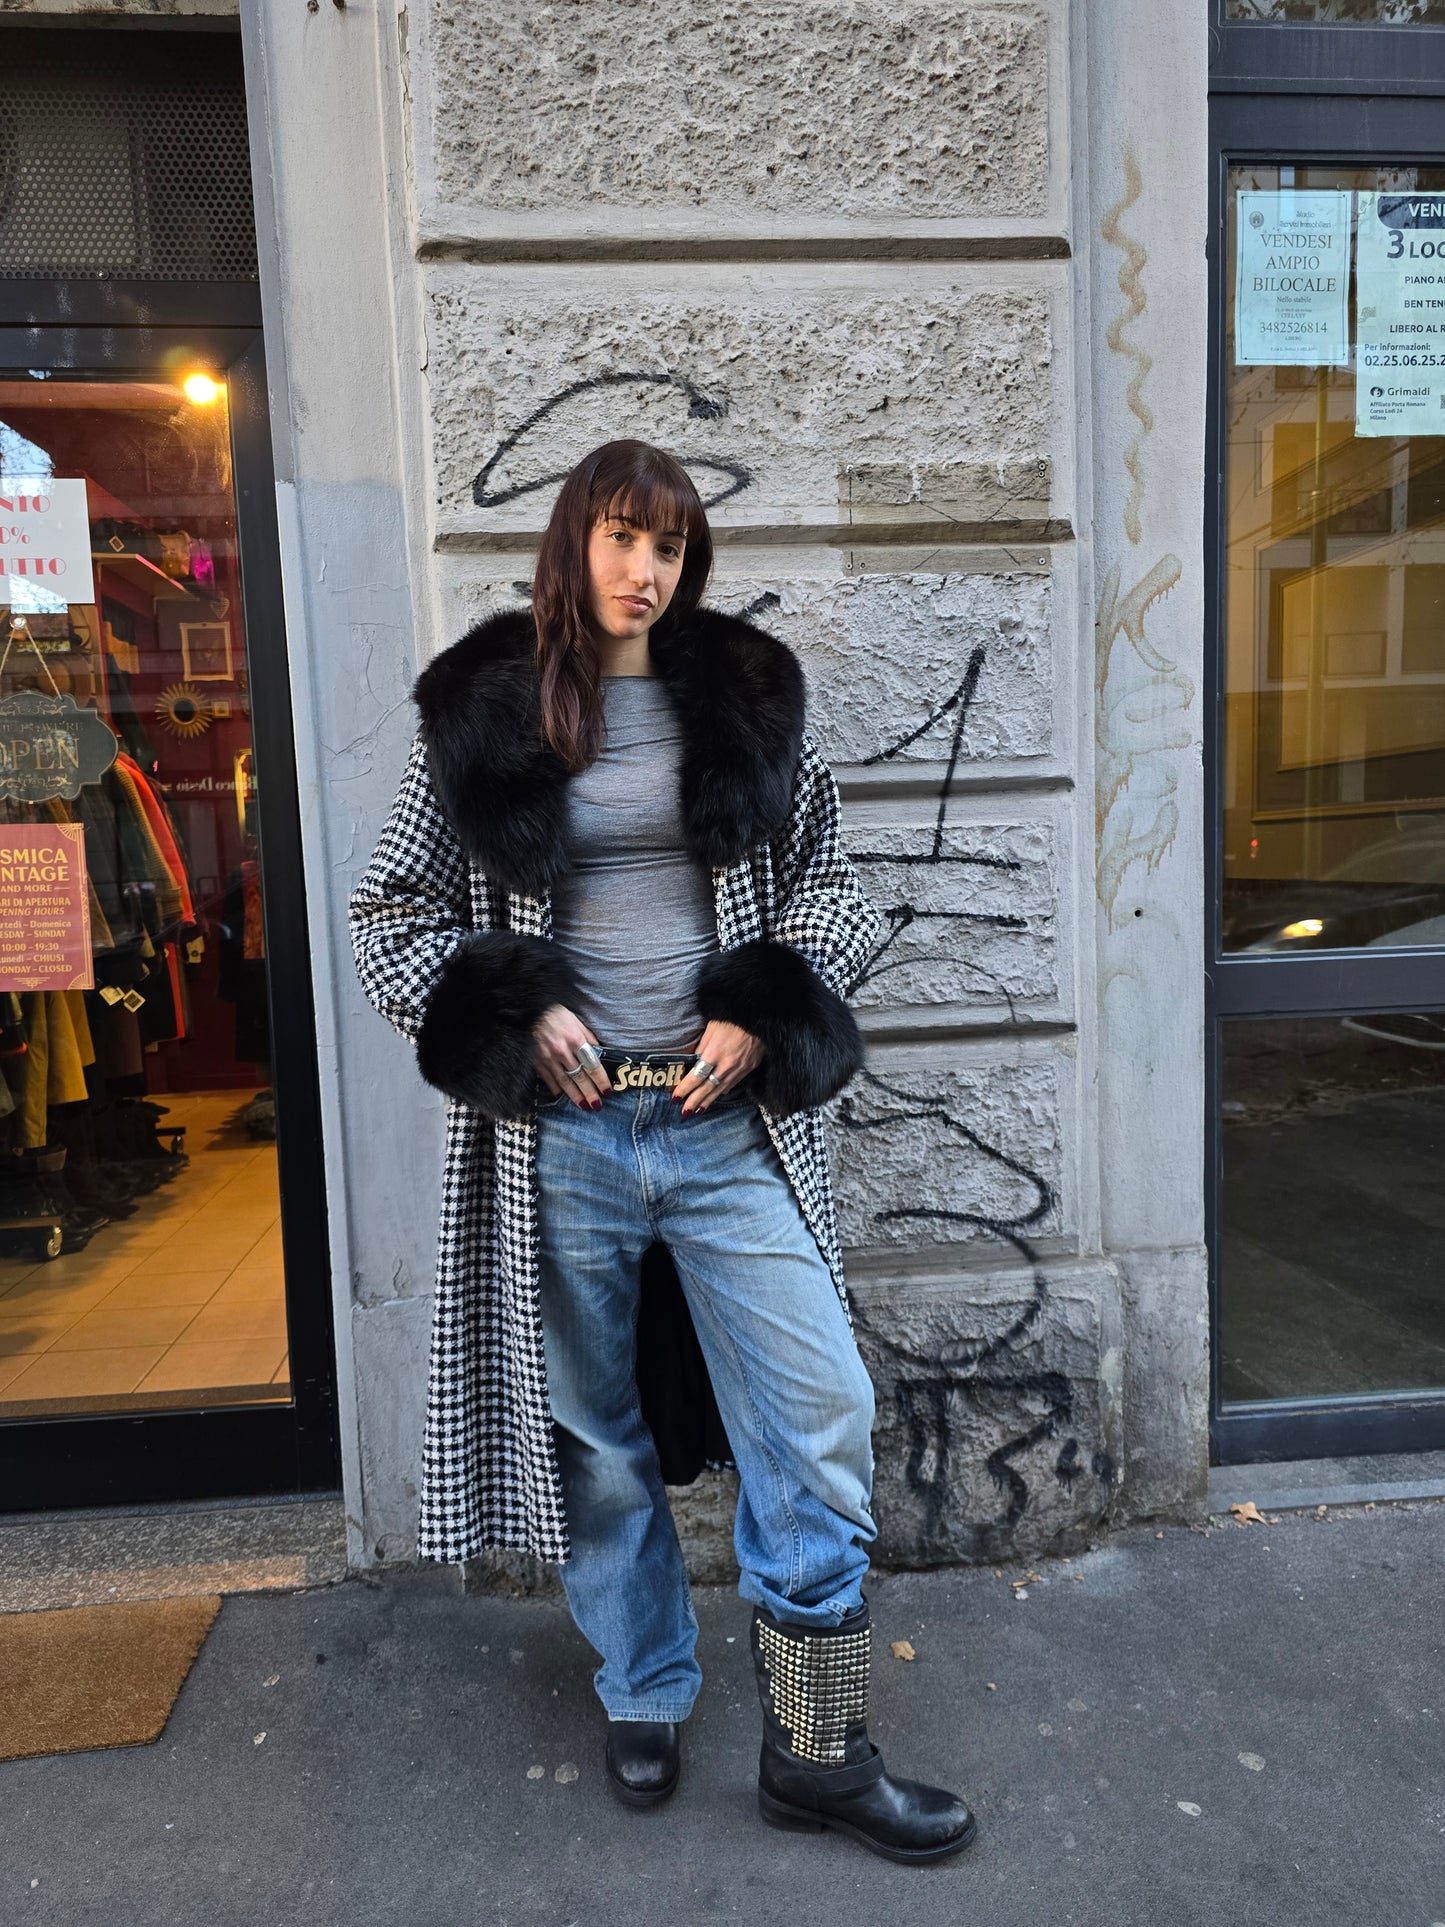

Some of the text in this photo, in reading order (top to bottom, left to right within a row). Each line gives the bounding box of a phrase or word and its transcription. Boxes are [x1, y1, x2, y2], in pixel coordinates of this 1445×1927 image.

[1408, 203, 1445, 217] VEN
[1260, 234, 1332, 248] VENDESI
[1387, 229, 1405, 259] 3
[1265, 256, 1320, 270] AMPIO
[1253, 277, 1337, 292] BILOCALE
[1404, 276, 1445, 284] PIANO A
[1404, 300, 1445, 308] BEN TEN
[1260, 322, 1327, 333] 3482526814
[1389, 324, 1424, 333] LIBERO
[1425, 324, 1438, 333] AL
[1364, 342, 1431, 351] Per informazioni:
[1387, 387, 1430, 396] Grimaldi
[0, 848, 68, 864] SMICA
[1, 866, 70, 882] NTAGE
[1, 884, 53, 893] AND MORE
[13, 898, 23, 906] DI
[25, 897, 71, 906] APERTURA
[33, 907, 65, 915] HOURS
[30, 920, 71, 928] Domenica
[34, 930, 66, 938] SUNDAY
[1, 943, 59, 952] 10:00 19:30
[33, 954, 65, 962] CHIUSI
[38, 964, 73, 973] CLOSED
